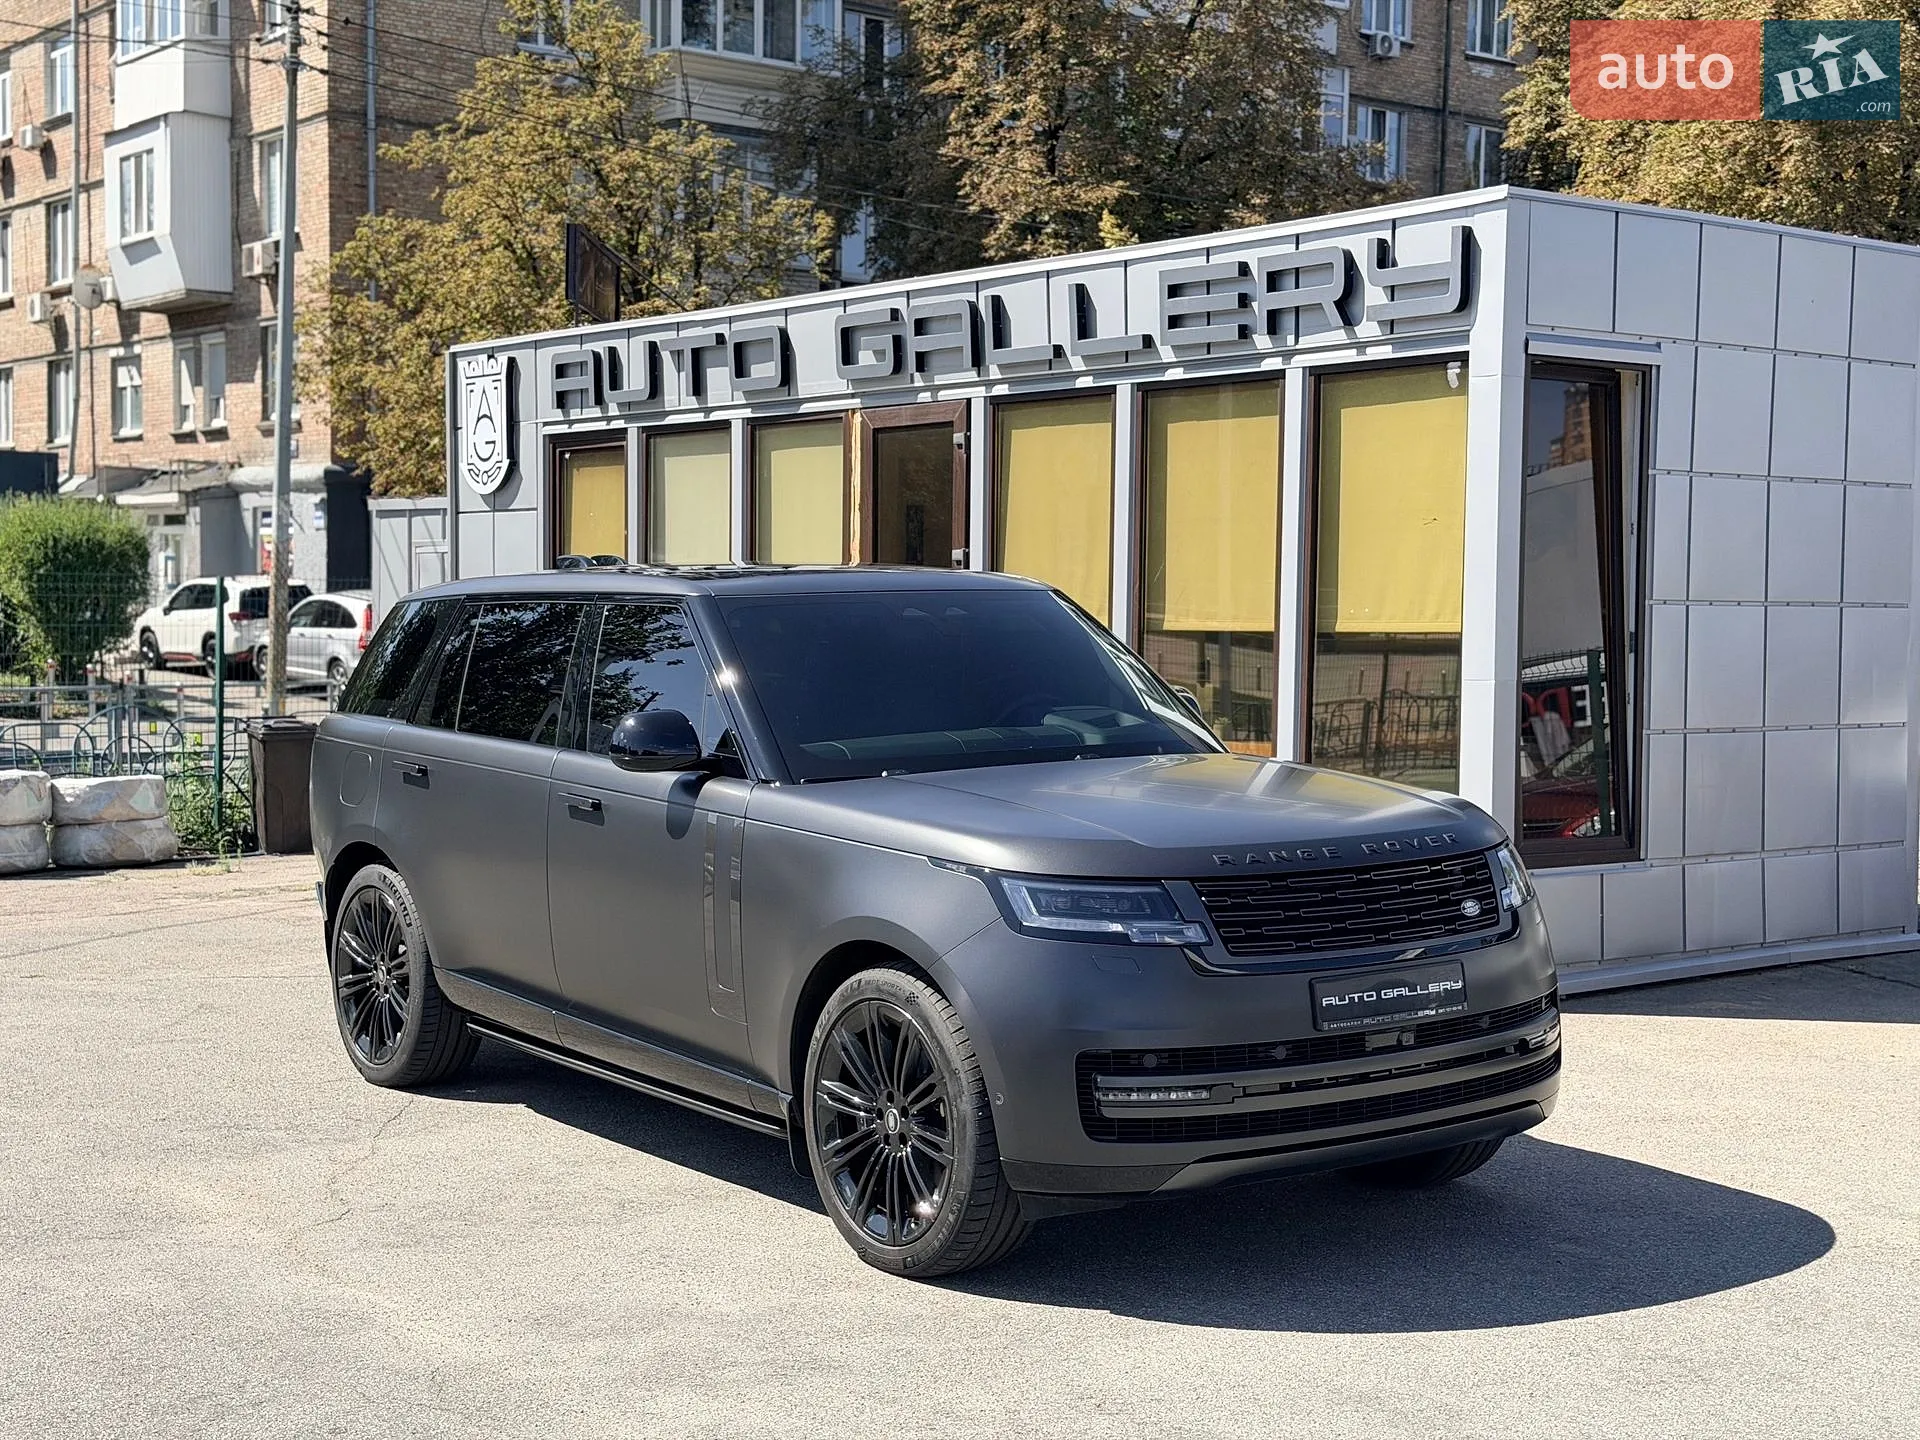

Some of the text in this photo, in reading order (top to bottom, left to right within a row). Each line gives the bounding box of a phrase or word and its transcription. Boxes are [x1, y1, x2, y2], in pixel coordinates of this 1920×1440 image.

[550, 225, 1473, 410] AUTO GALLERY
[1211, 832, 1459, 867] RANGE ROVER
[1322, 979, 1463, 1007] AUTO GALLERY
